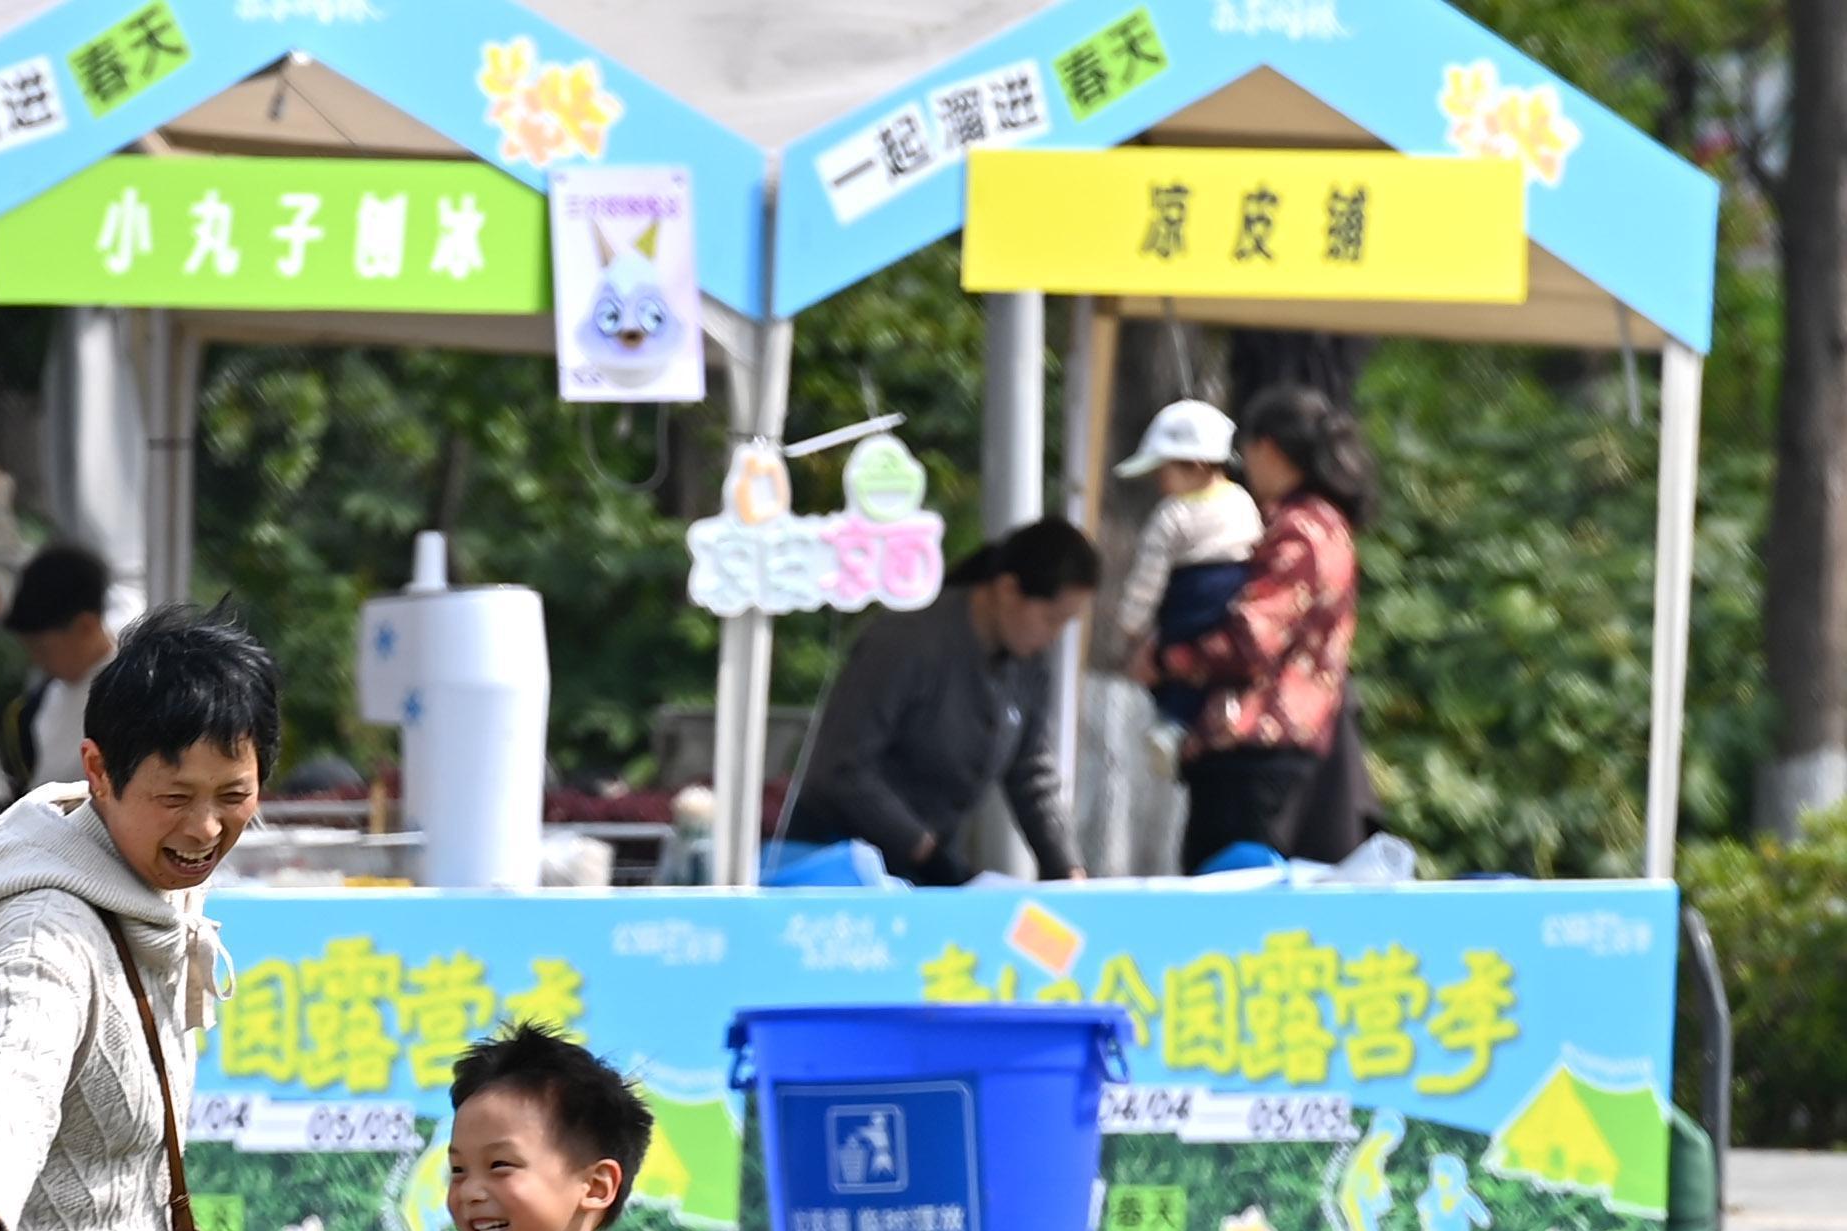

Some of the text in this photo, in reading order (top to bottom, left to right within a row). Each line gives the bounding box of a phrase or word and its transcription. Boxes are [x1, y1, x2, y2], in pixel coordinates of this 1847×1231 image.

[72, 5, 187, 103] 春天
[1056, 13, 1166, 107] 春天
[198, 935, 587, 1092] 园露营
